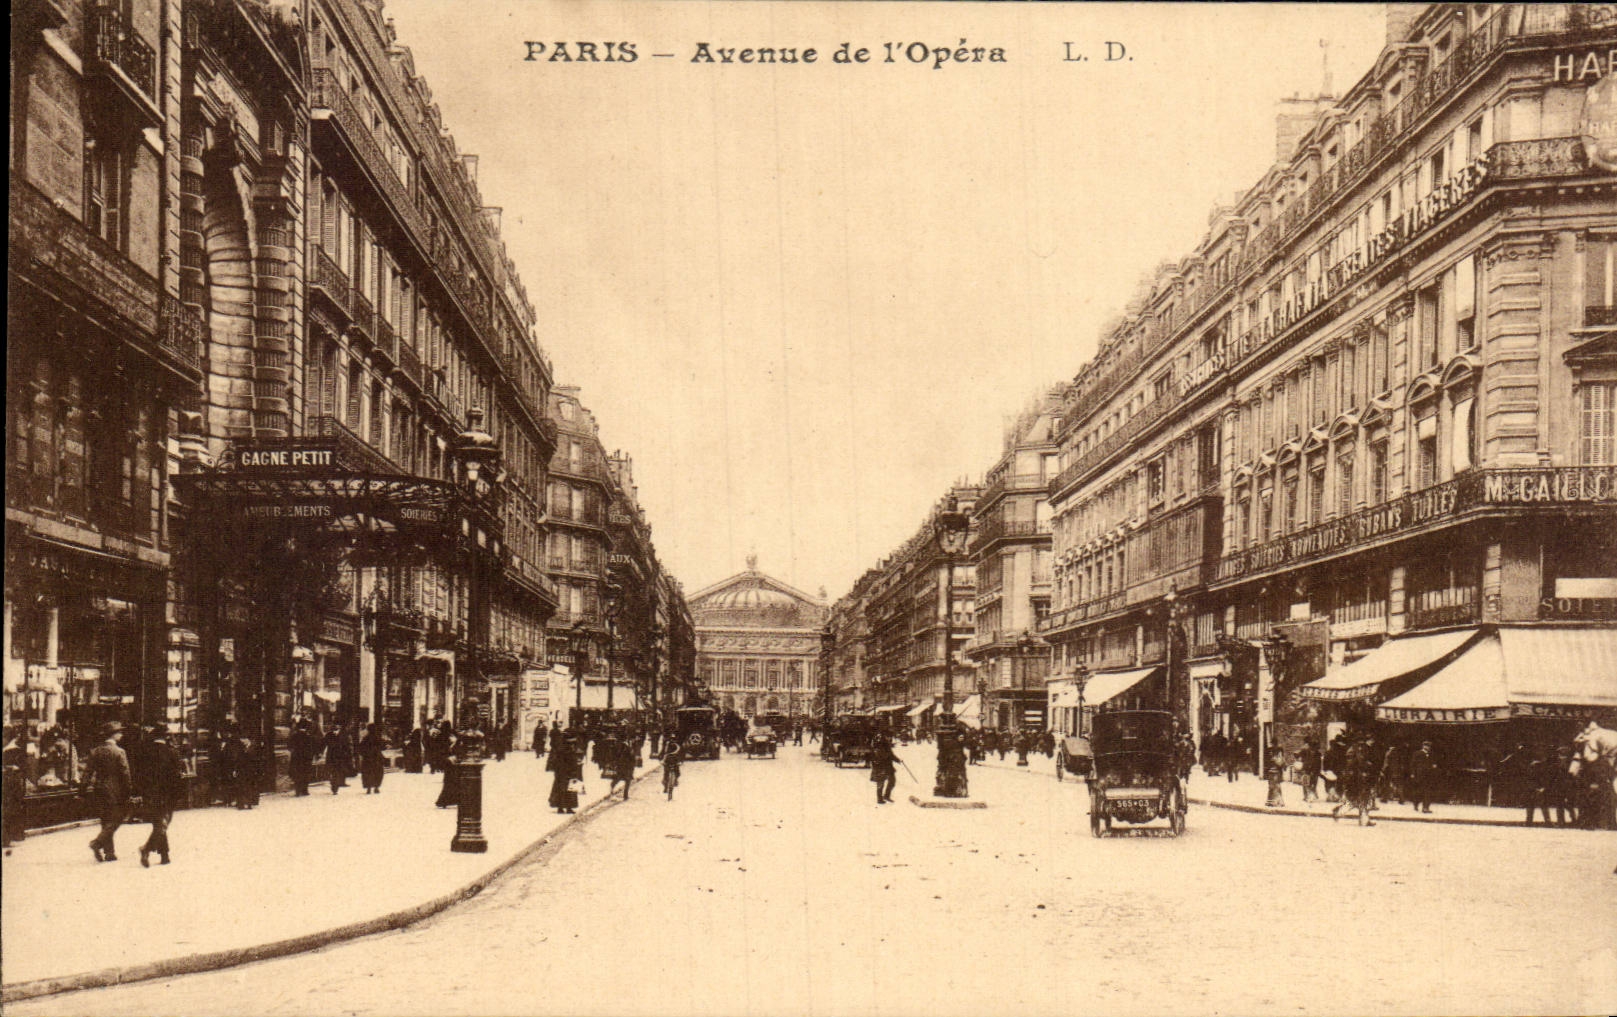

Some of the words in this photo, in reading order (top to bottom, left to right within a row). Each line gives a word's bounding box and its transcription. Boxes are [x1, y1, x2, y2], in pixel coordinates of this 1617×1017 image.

[241, 450, 288, 466] GAGNE
[292, 450, 333, 466] PETIT
[1384, 706, 1500, 722] LIBRAIRIE
